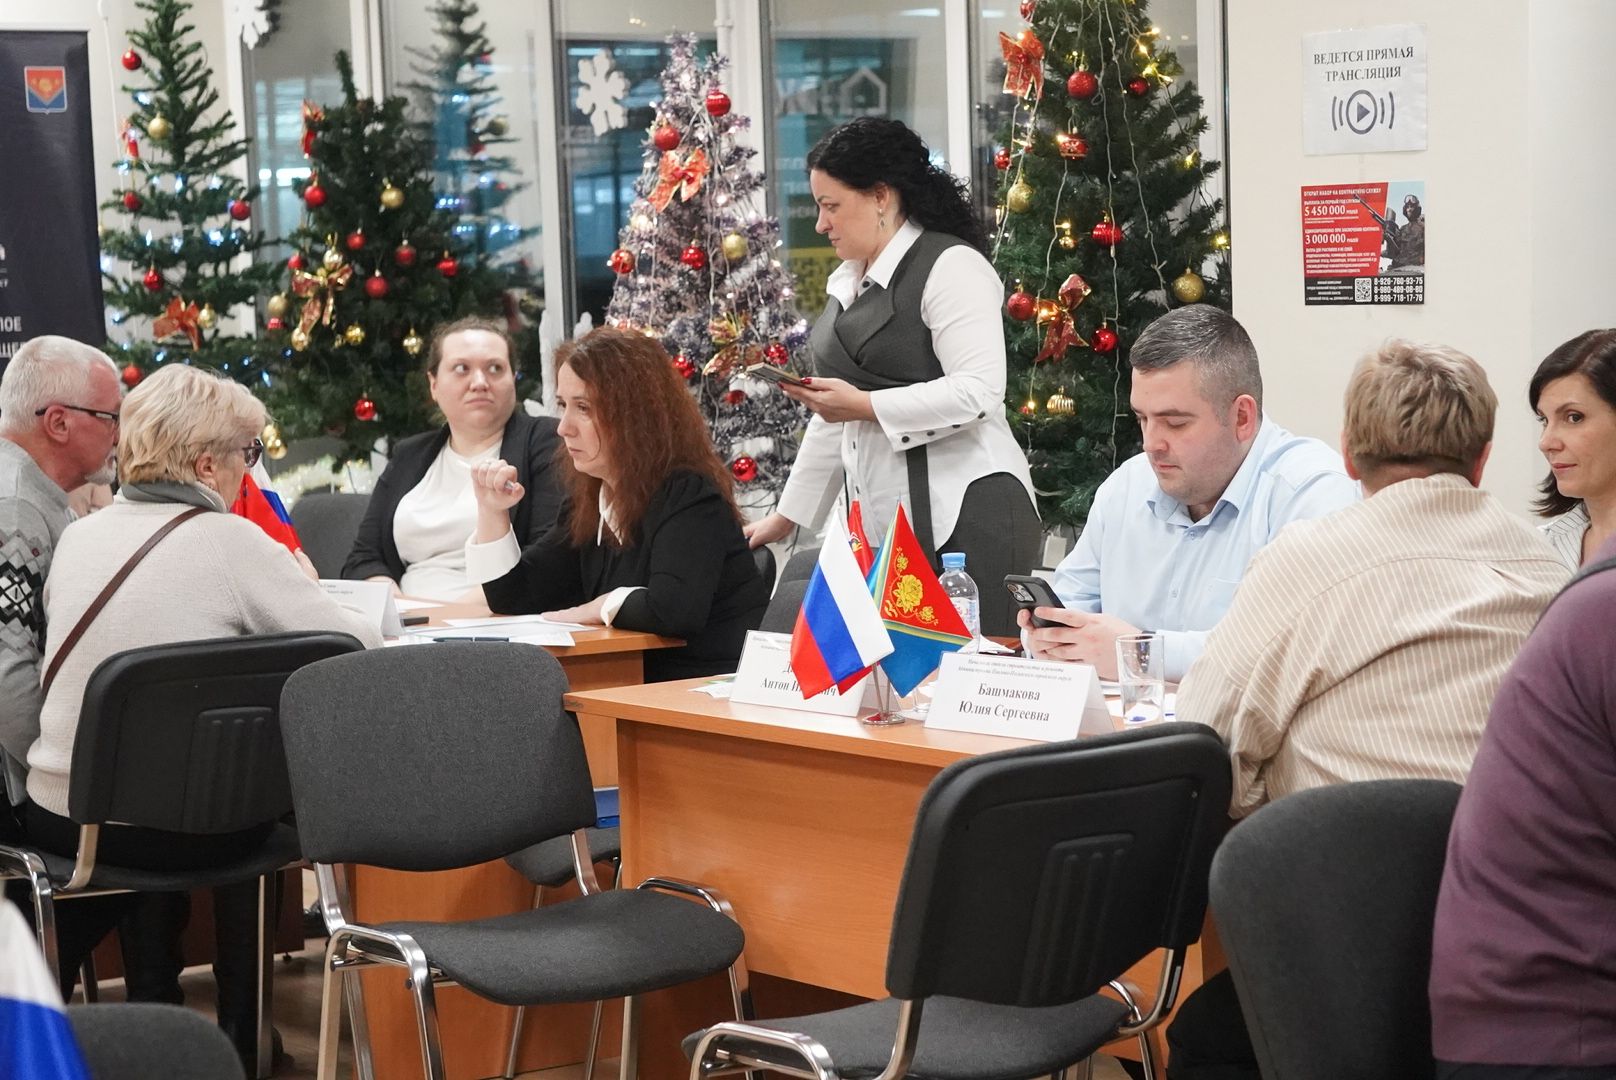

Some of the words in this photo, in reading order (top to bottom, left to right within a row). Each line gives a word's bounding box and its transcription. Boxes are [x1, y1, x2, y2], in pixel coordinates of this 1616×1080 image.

[1313, 51, 1363, 65] ВЕДЕТСЯ
[1366, 46, 1414, 61] ПРЯМАЯ
[1325, 66, 1401, 82] ТРАНСЛЯЦИЯ
[1305, 207, 1310, 217] 5
[1312, 207, 1328, 216] 450
[1330, 206, 1346, 215] 000
[1306, 235, 1311, 245] 3
[1313, 235, 1328, 244] 000
[1330, 234, 1346, 243] 000
[760, 678, 790, 691] Антон
[978, 683, 1041, 701] Башмакова
[958, 700, 991, 716] Юлия
[994, 704, 1050, 723] Сергеевна
